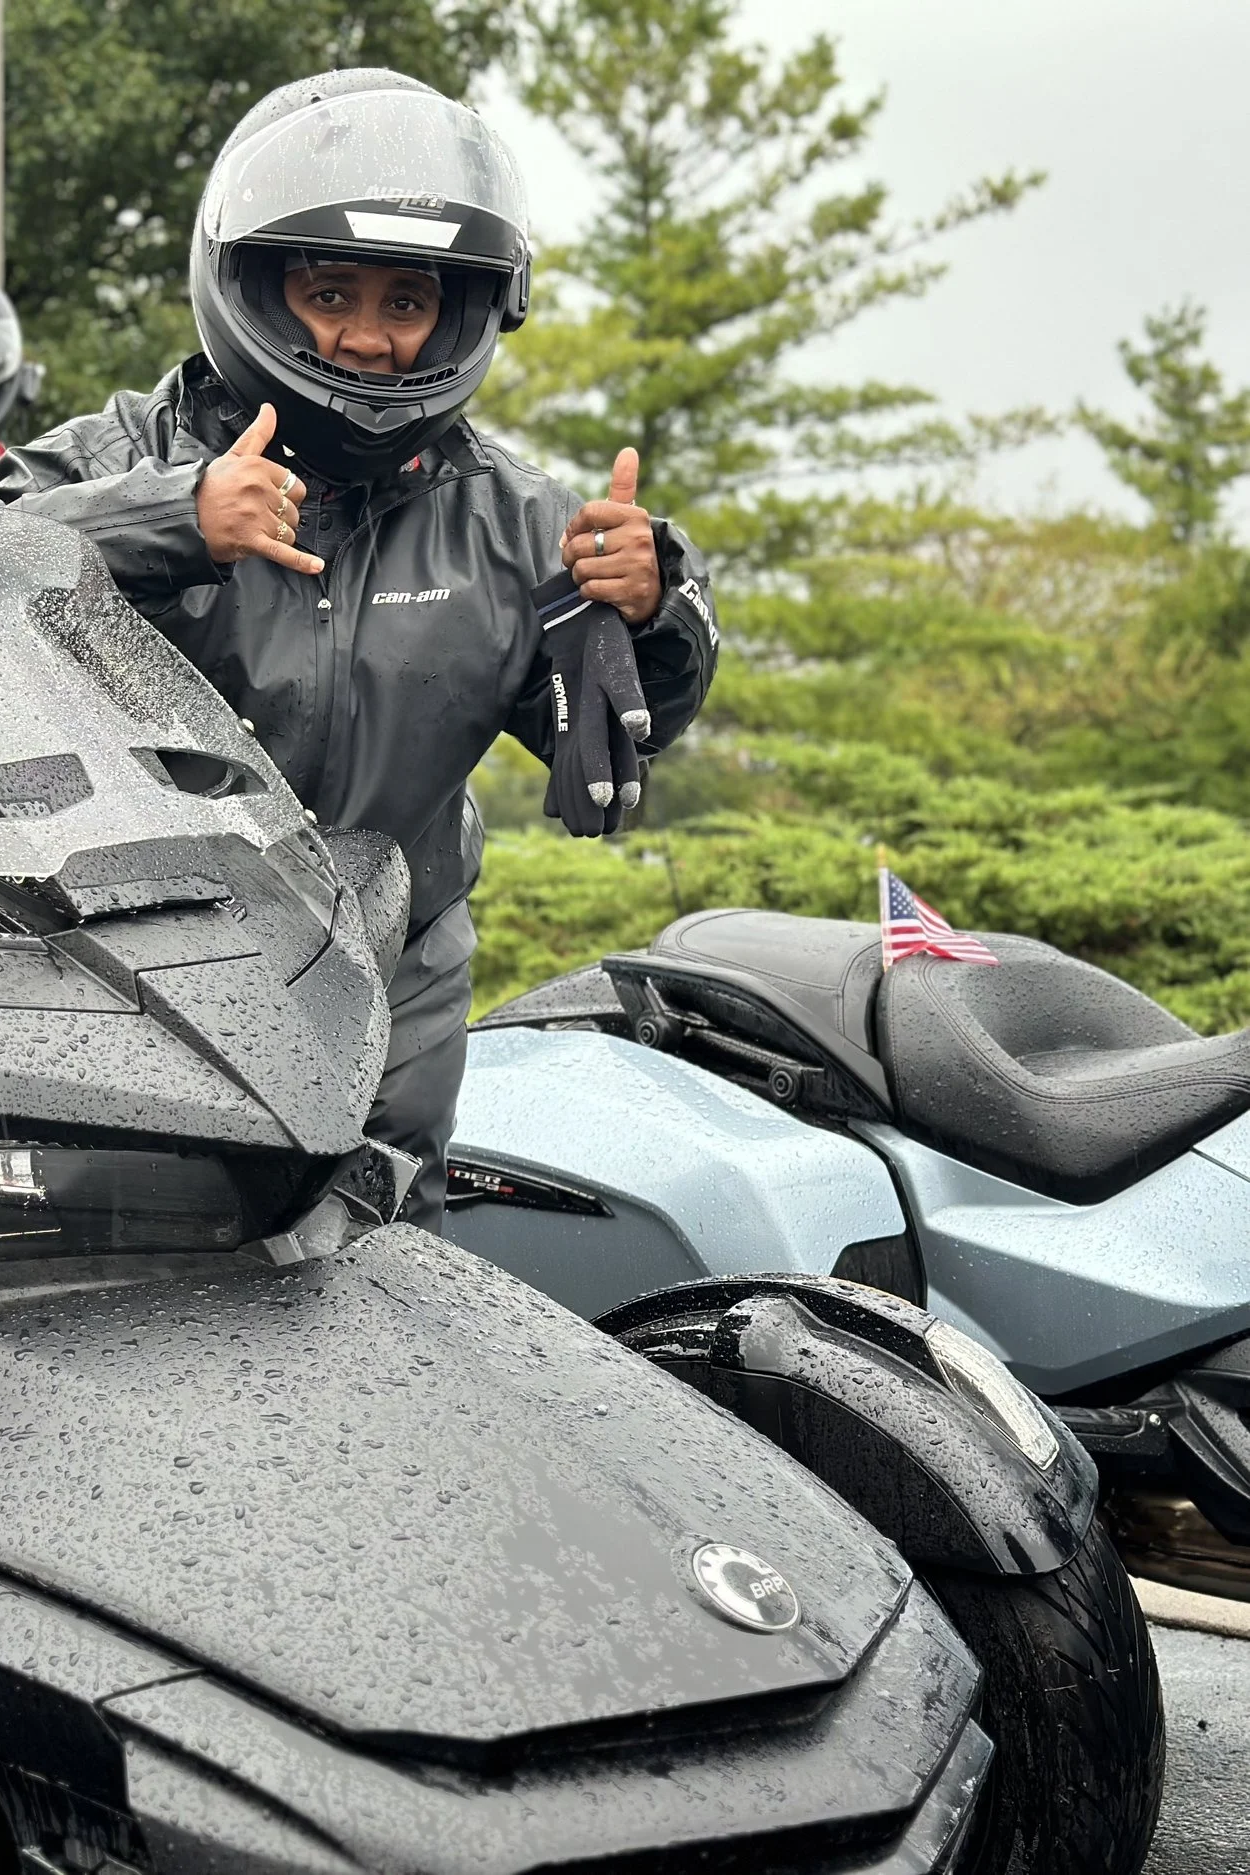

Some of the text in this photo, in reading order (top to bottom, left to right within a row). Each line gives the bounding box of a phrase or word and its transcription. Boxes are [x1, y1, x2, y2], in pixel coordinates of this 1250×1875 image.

[371, 588, 451, 605] can-am
[552, 673, 569, 732] DRYMILE
[749, 1575, 784, 1600] BRP
